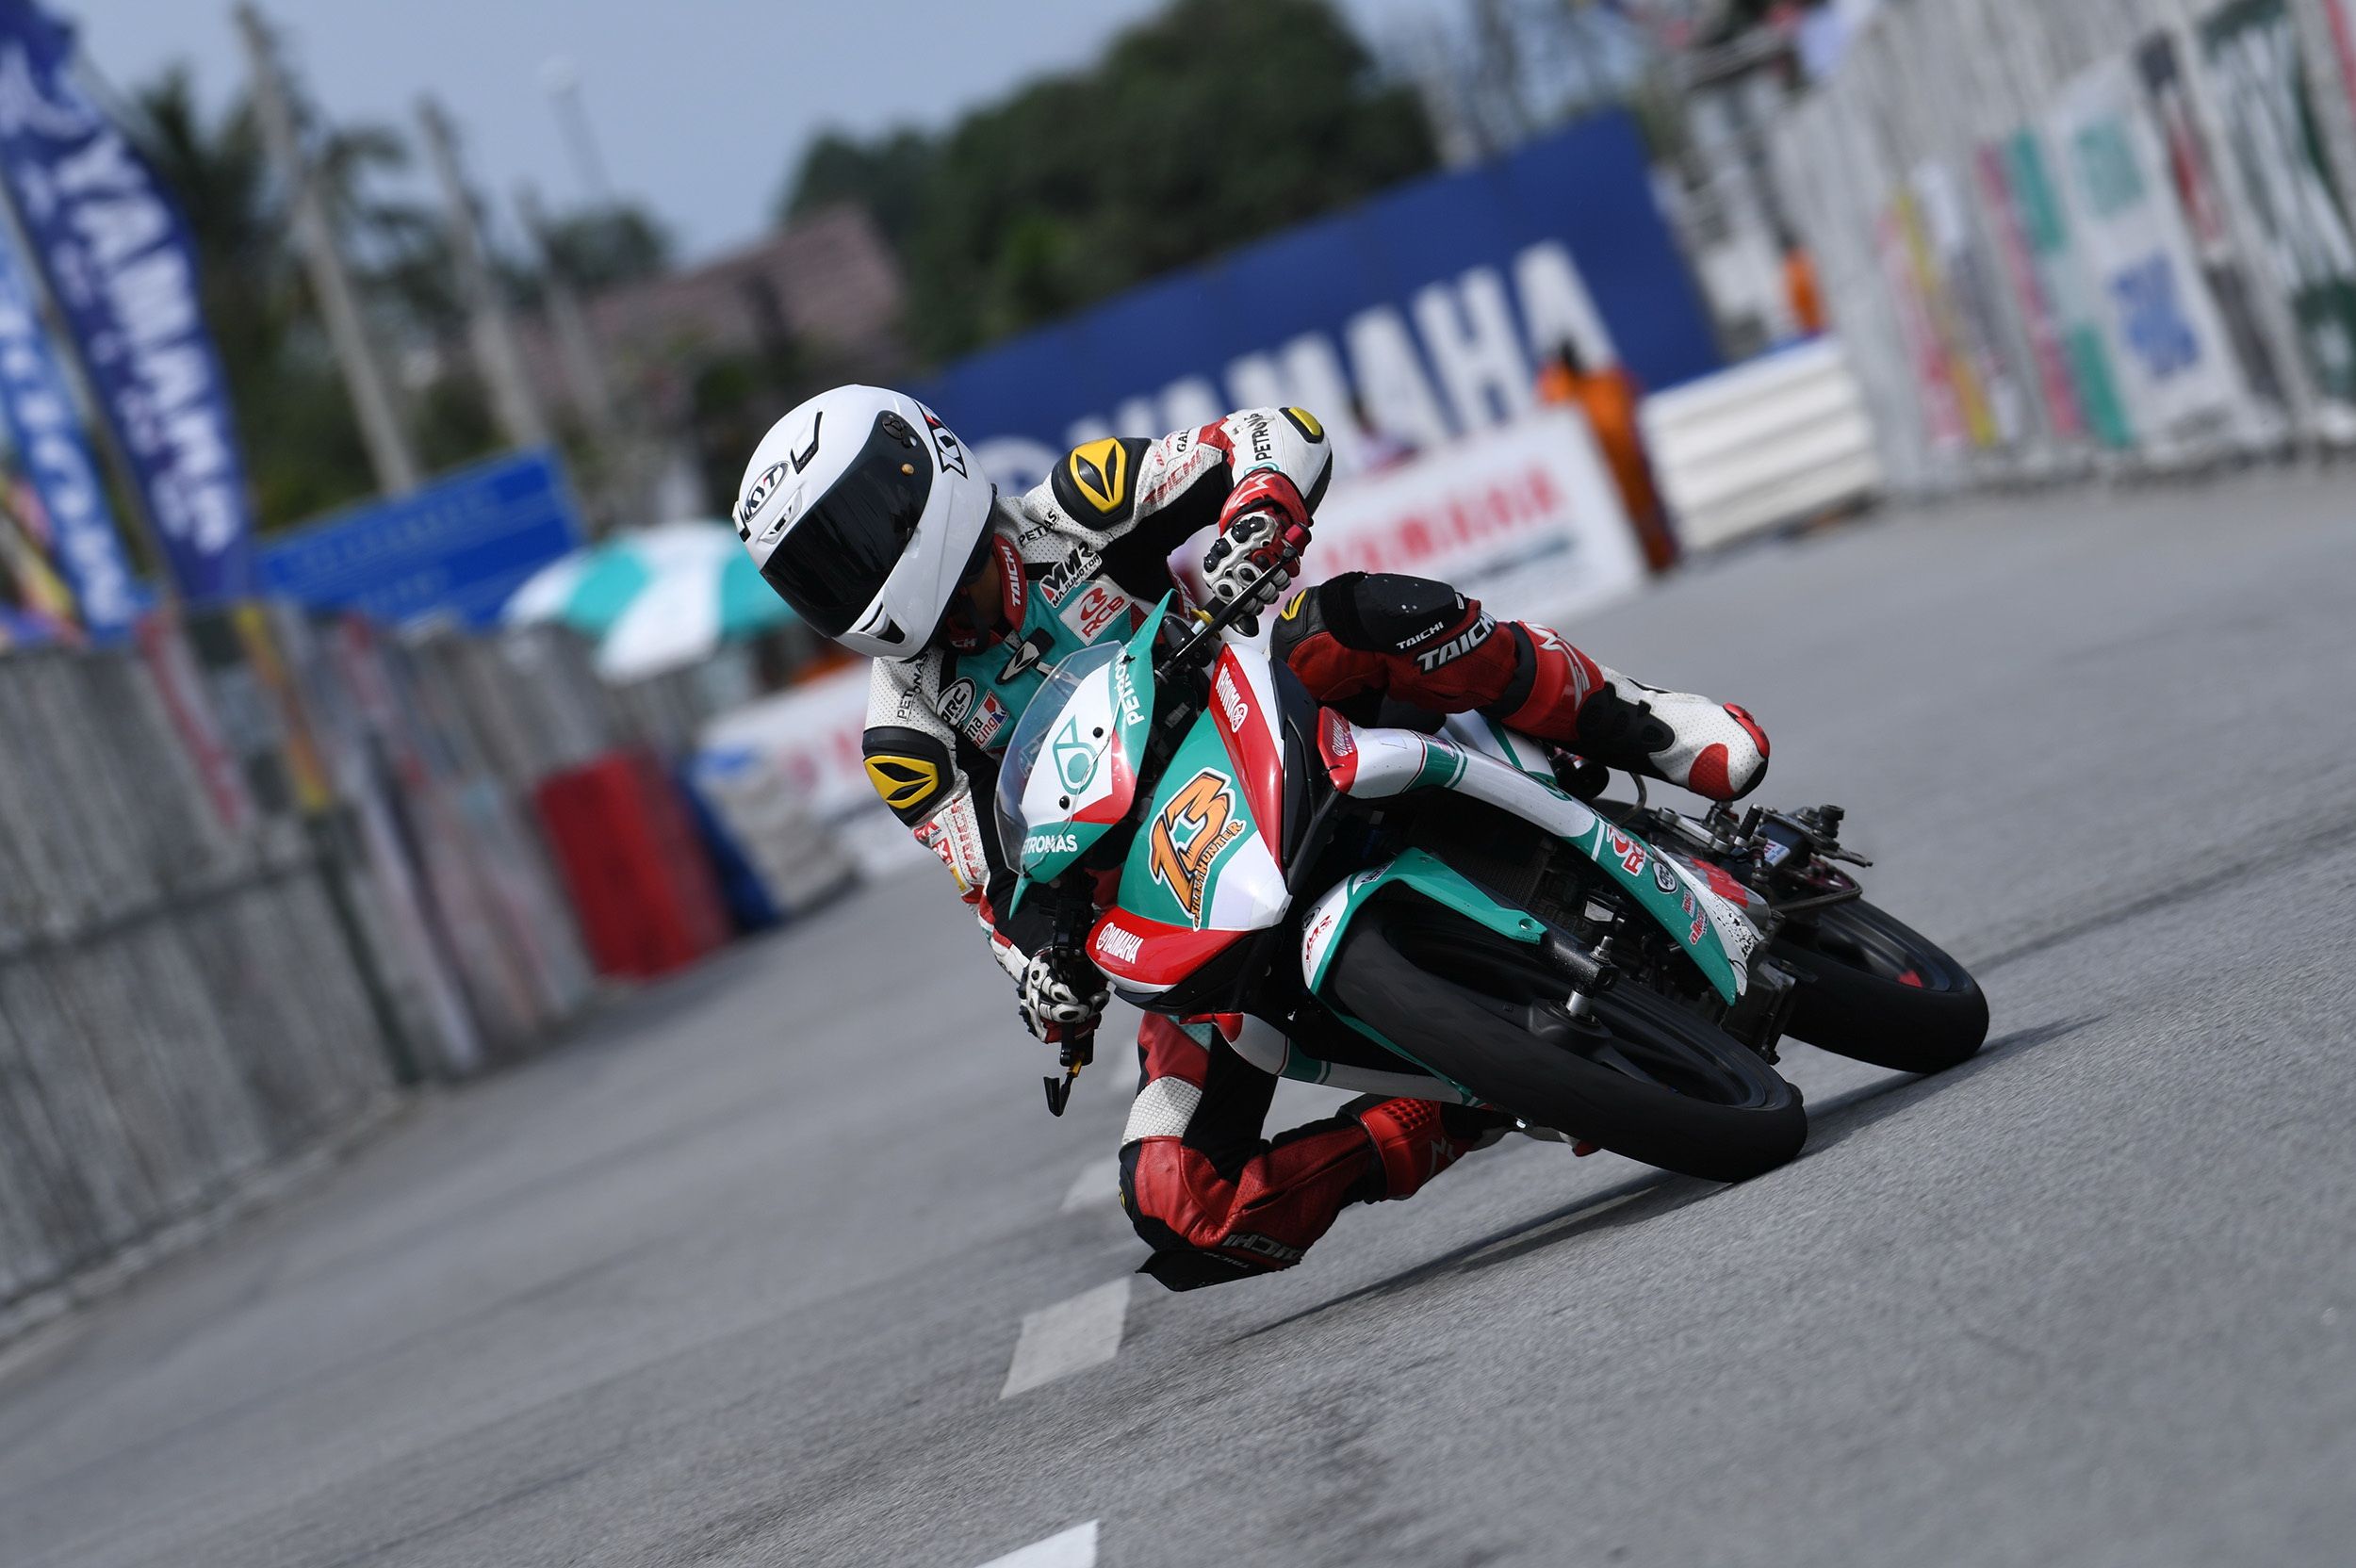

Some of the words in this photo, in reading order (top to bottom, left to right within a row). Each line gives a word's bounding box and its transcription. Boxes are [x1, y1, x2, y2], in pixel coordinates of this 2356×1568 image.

[744, 465, 779, 520] KYT
[1001, 546, 1022, 607] TAICHI
[1052, 554, 1101, 607] MAJUMOTOR
[1082, 596, 1125, 638] RCB
[1396, 621, 1445, 650] TAICHI
[1416, 611, 1497, 672] TAICH
[973, 716, 999, 747] acing
[1152, 772, 1231, 914] 13
[1102, 926, 1144, 964] YAMAHA
[1223, 1233, 1295, 1261] AICHI
